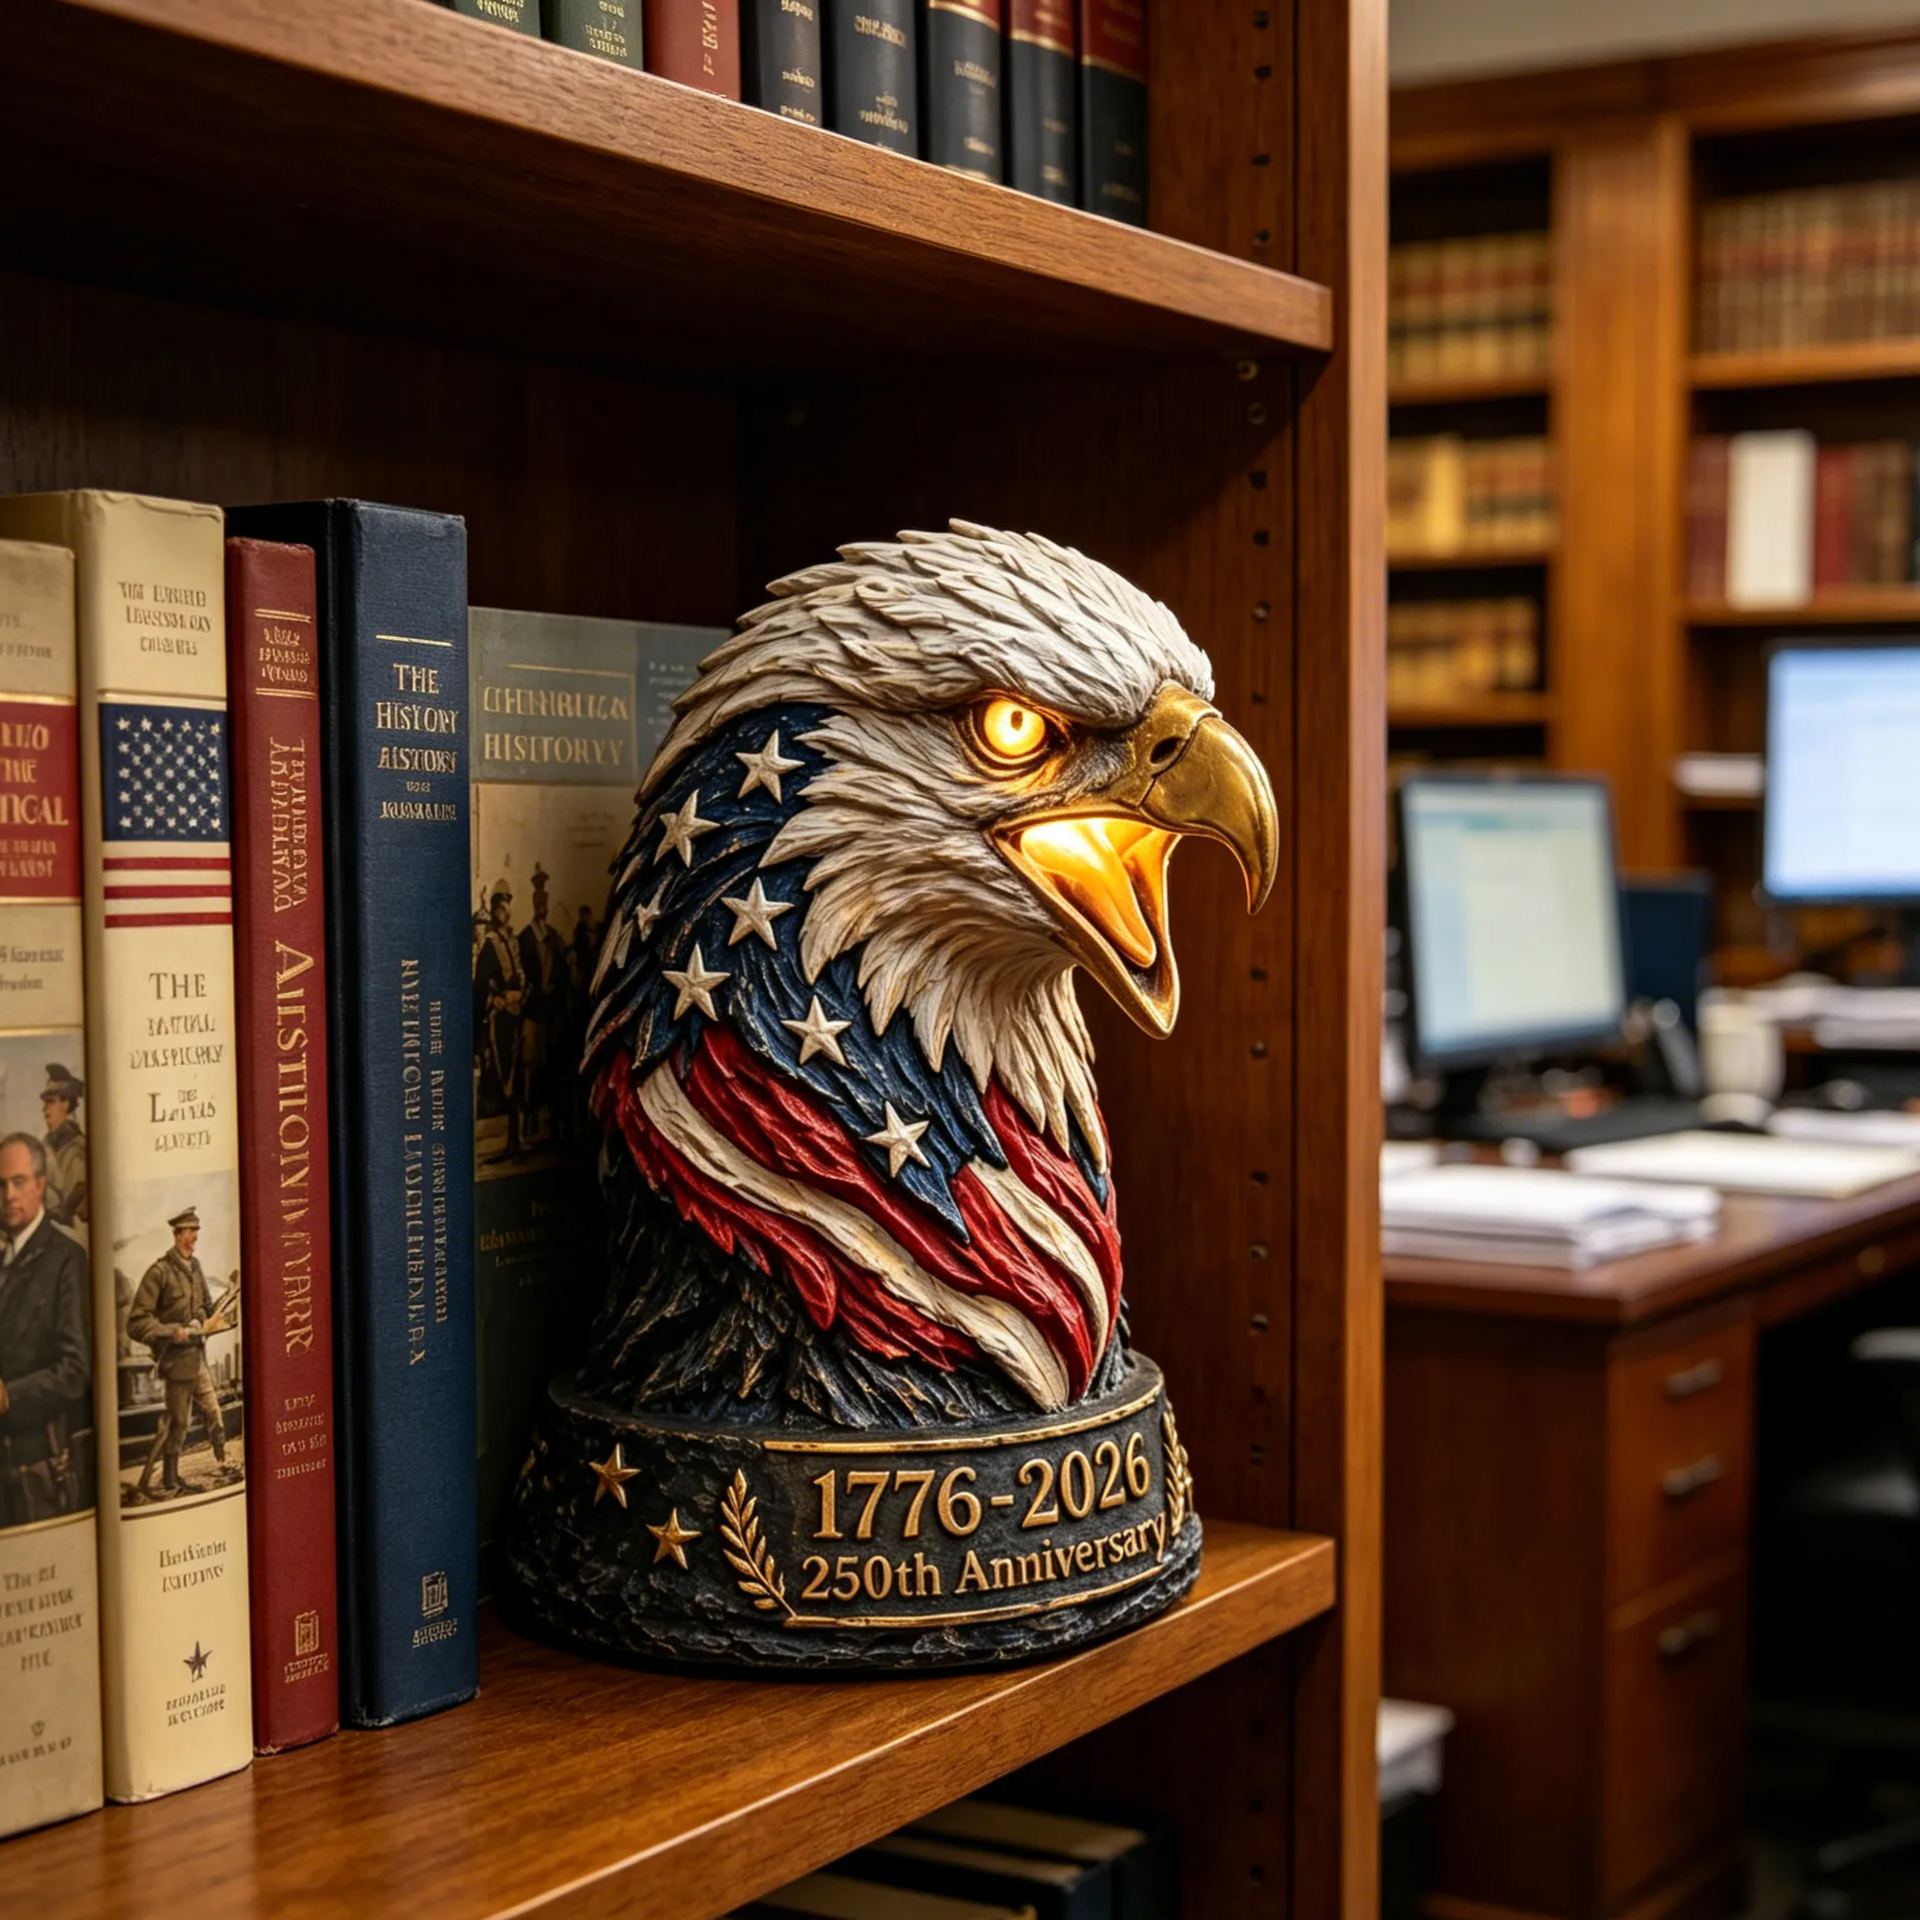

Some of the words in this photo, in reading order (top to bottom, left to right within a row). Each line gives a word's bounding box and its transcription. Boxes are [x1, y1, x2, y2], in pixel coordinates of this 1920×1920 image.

[393, 663, 440, 694] THE
[149, 972, 206, 1000] THE
[812, 1432, 1150, 1540] 1776-2026
[801, 1552, 943, 1600] 250th
[954, 1512, 1166, 1594] Anniversary
